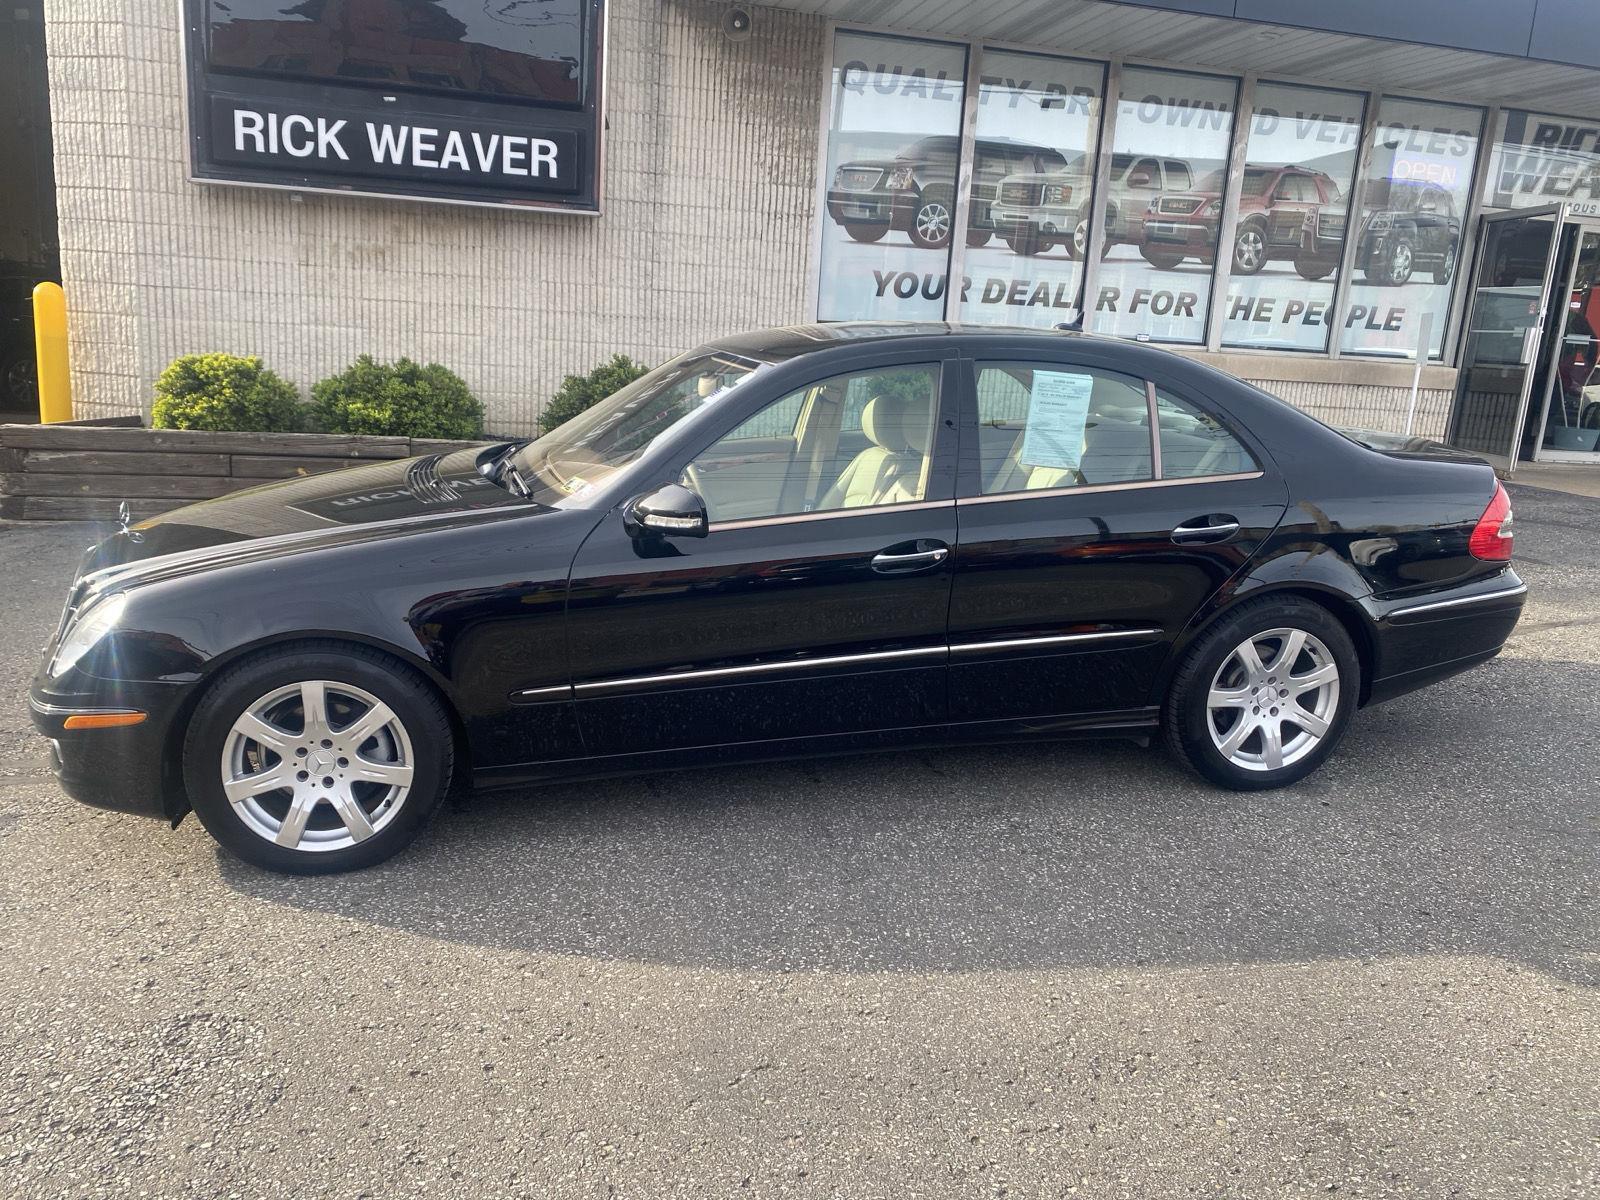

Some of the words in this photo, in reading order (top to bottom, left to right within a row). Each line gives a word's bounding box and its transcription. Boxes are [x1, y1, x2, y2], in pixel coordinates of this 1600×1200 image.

[841, 60, 1032, 109] QUALTY
[1040, 83, 1280, 136] PR-OWND
[233, 109, 350, 161] RICK
[365, 121, 558, 179] WEAVER
[1533, 122, 1600, 160] RIC
[1393, 160, 1457, 184] OPEN
[1129, 288, 1198, 318] FOR
[1226, 295, 1277, 322] HE
